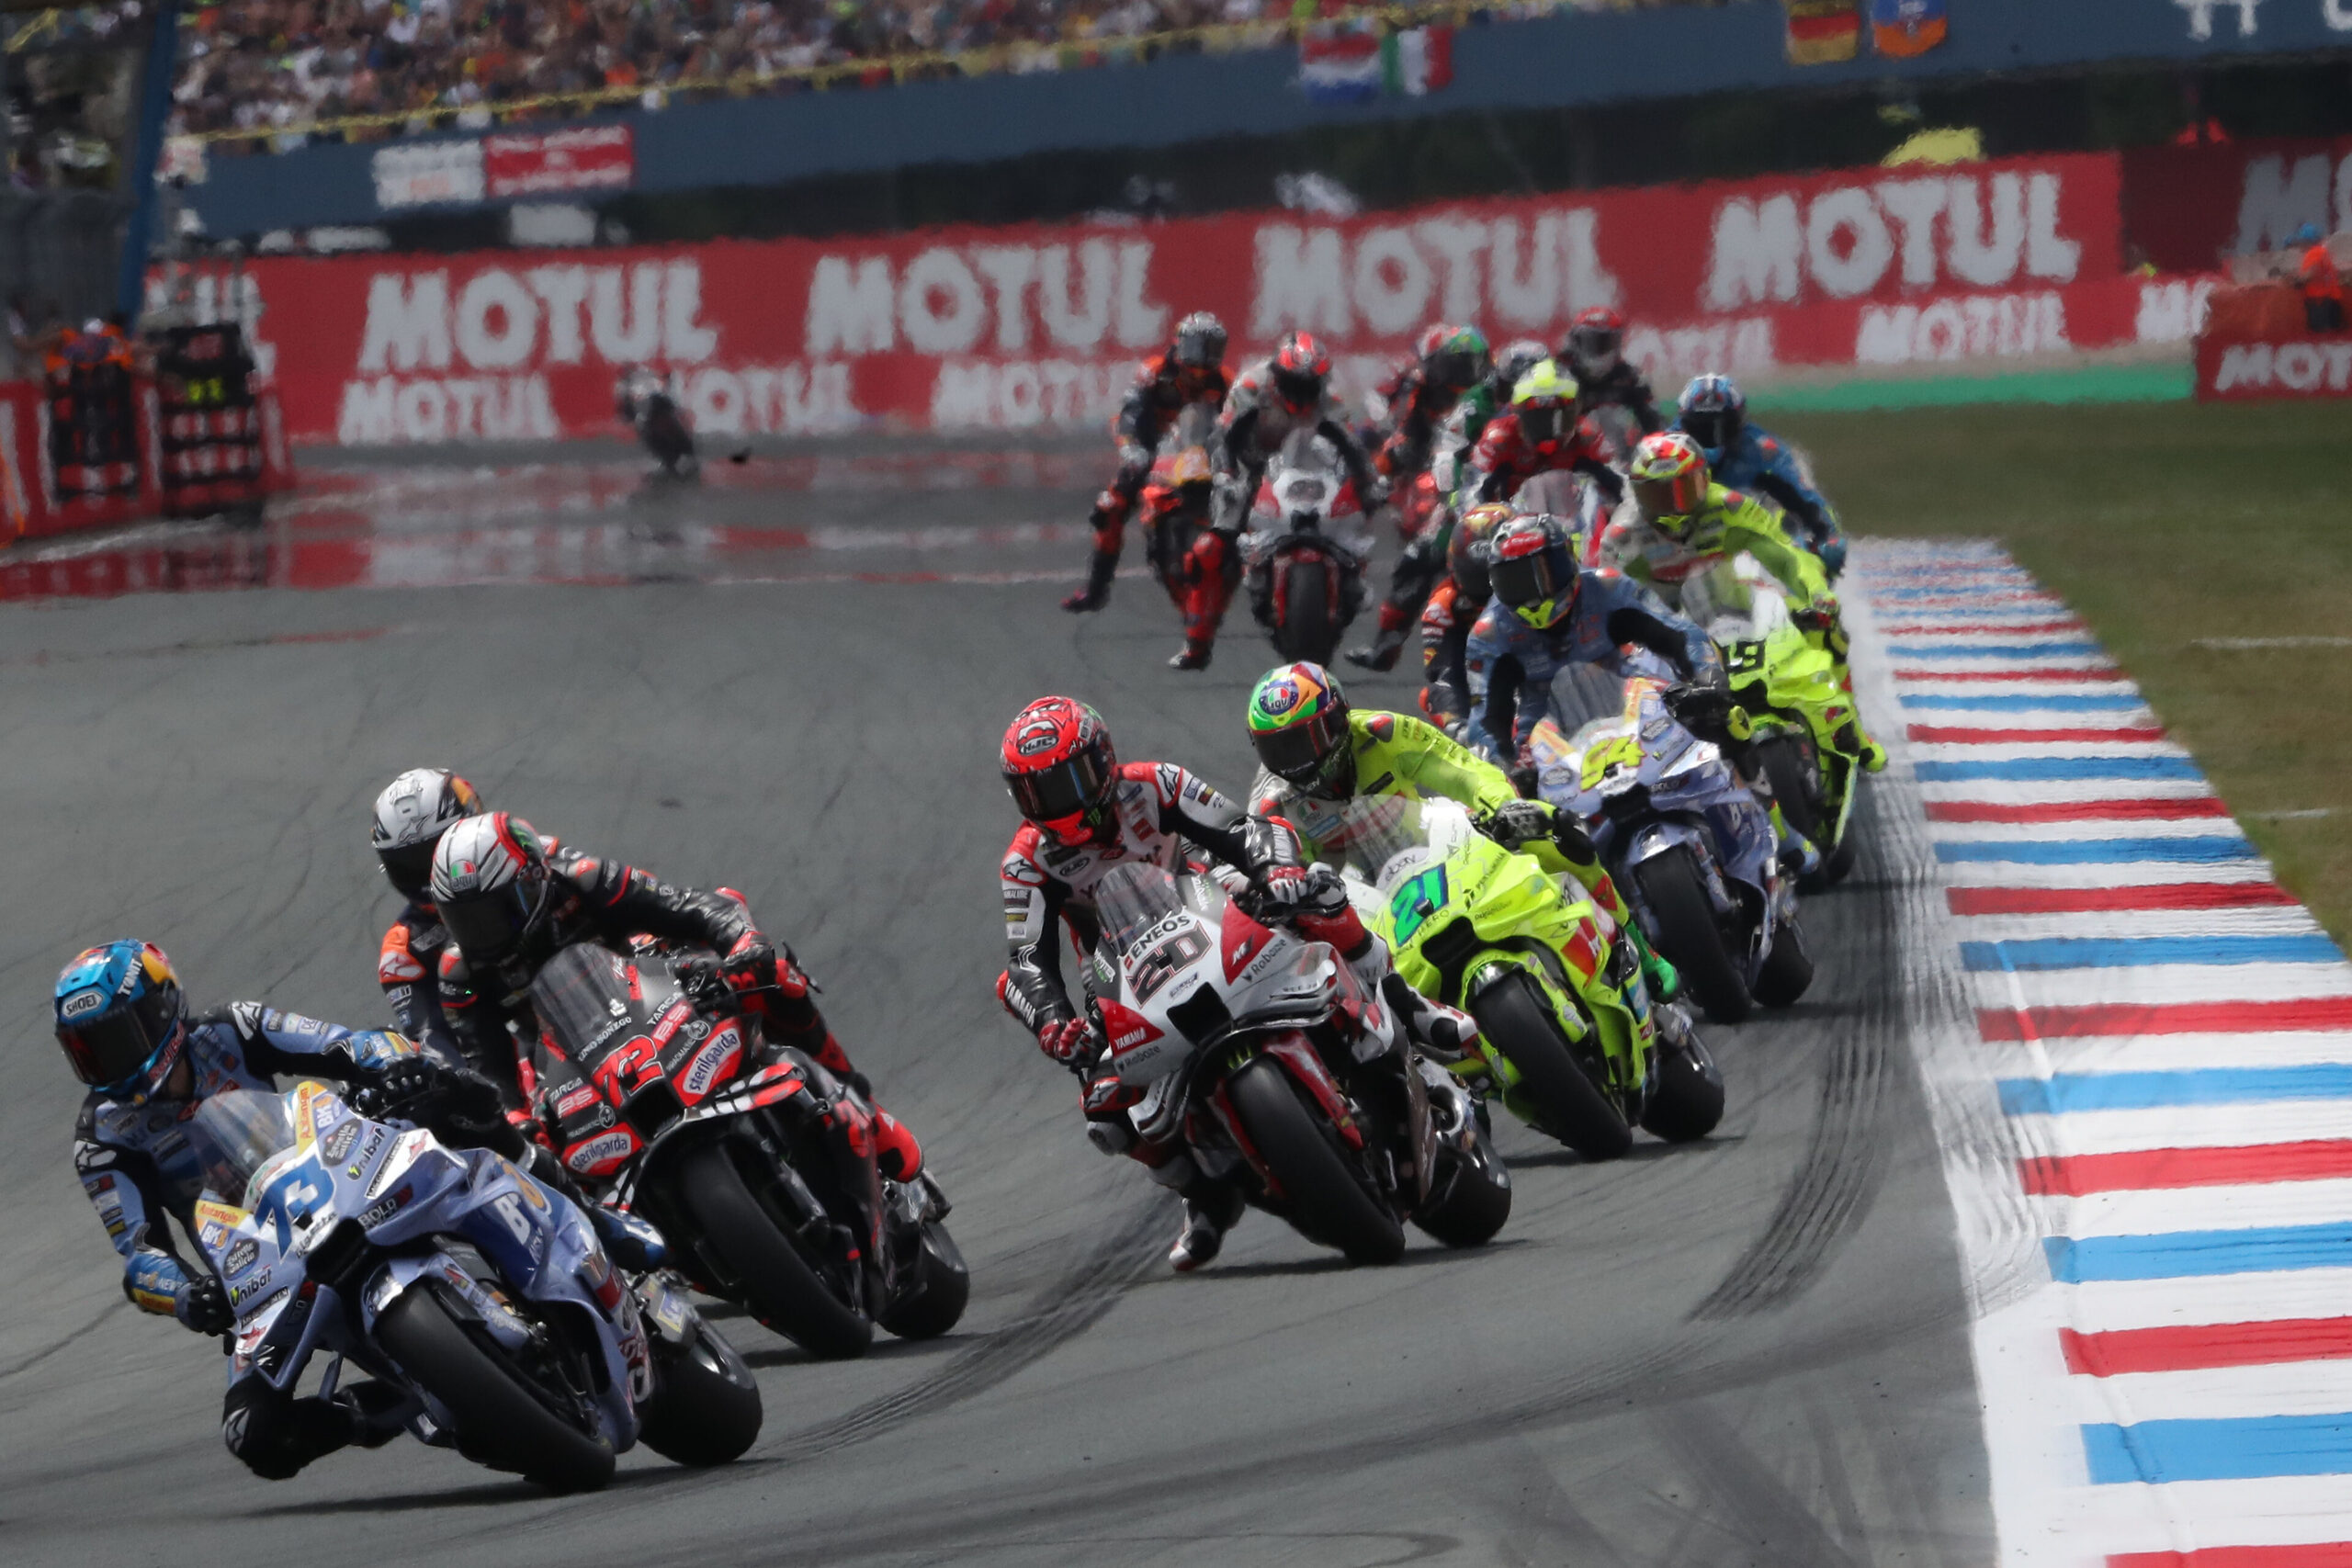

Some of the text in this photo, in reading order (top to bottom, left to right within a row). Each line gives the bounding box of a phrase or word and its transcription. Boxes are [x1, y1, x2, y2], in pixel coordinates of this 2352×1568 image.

[1706, 172, 2081, 310] MOTUL
[806, 236, 1170, 356] MOTUL
[1250, 209, 1622, 342] MOTUL
[358, 258, 718, 371] MOTUL
[1854, 290, 2072, 363] MOTUL
[336, 373, 560, 446] MOTUL
[669, 364, 864, 435] OTUL
[1023, 736, 1056, 753] HJC
[1391, 863, 1450, 948] 21
[1132, 915, 1191, 959] ENEOS
[65, 993, 99, 1016] SHOEI
[646, 991, 684, 1026] TARGA
[1004, 977, 1036, 1028] YAMAHA
[690, 1032, 738, 1091] sterilgarda
[1114, 1026, 1148, 1050] YAMAHA
[549, 1077, 583, 1102] TARGA
[593, 1034, 666, 1110] 72
[557, 1087, 594, 1119] BS
[571, 1134, 628, 1170] sterilgarda
[231, 1268, 273, 1308] Unibat
